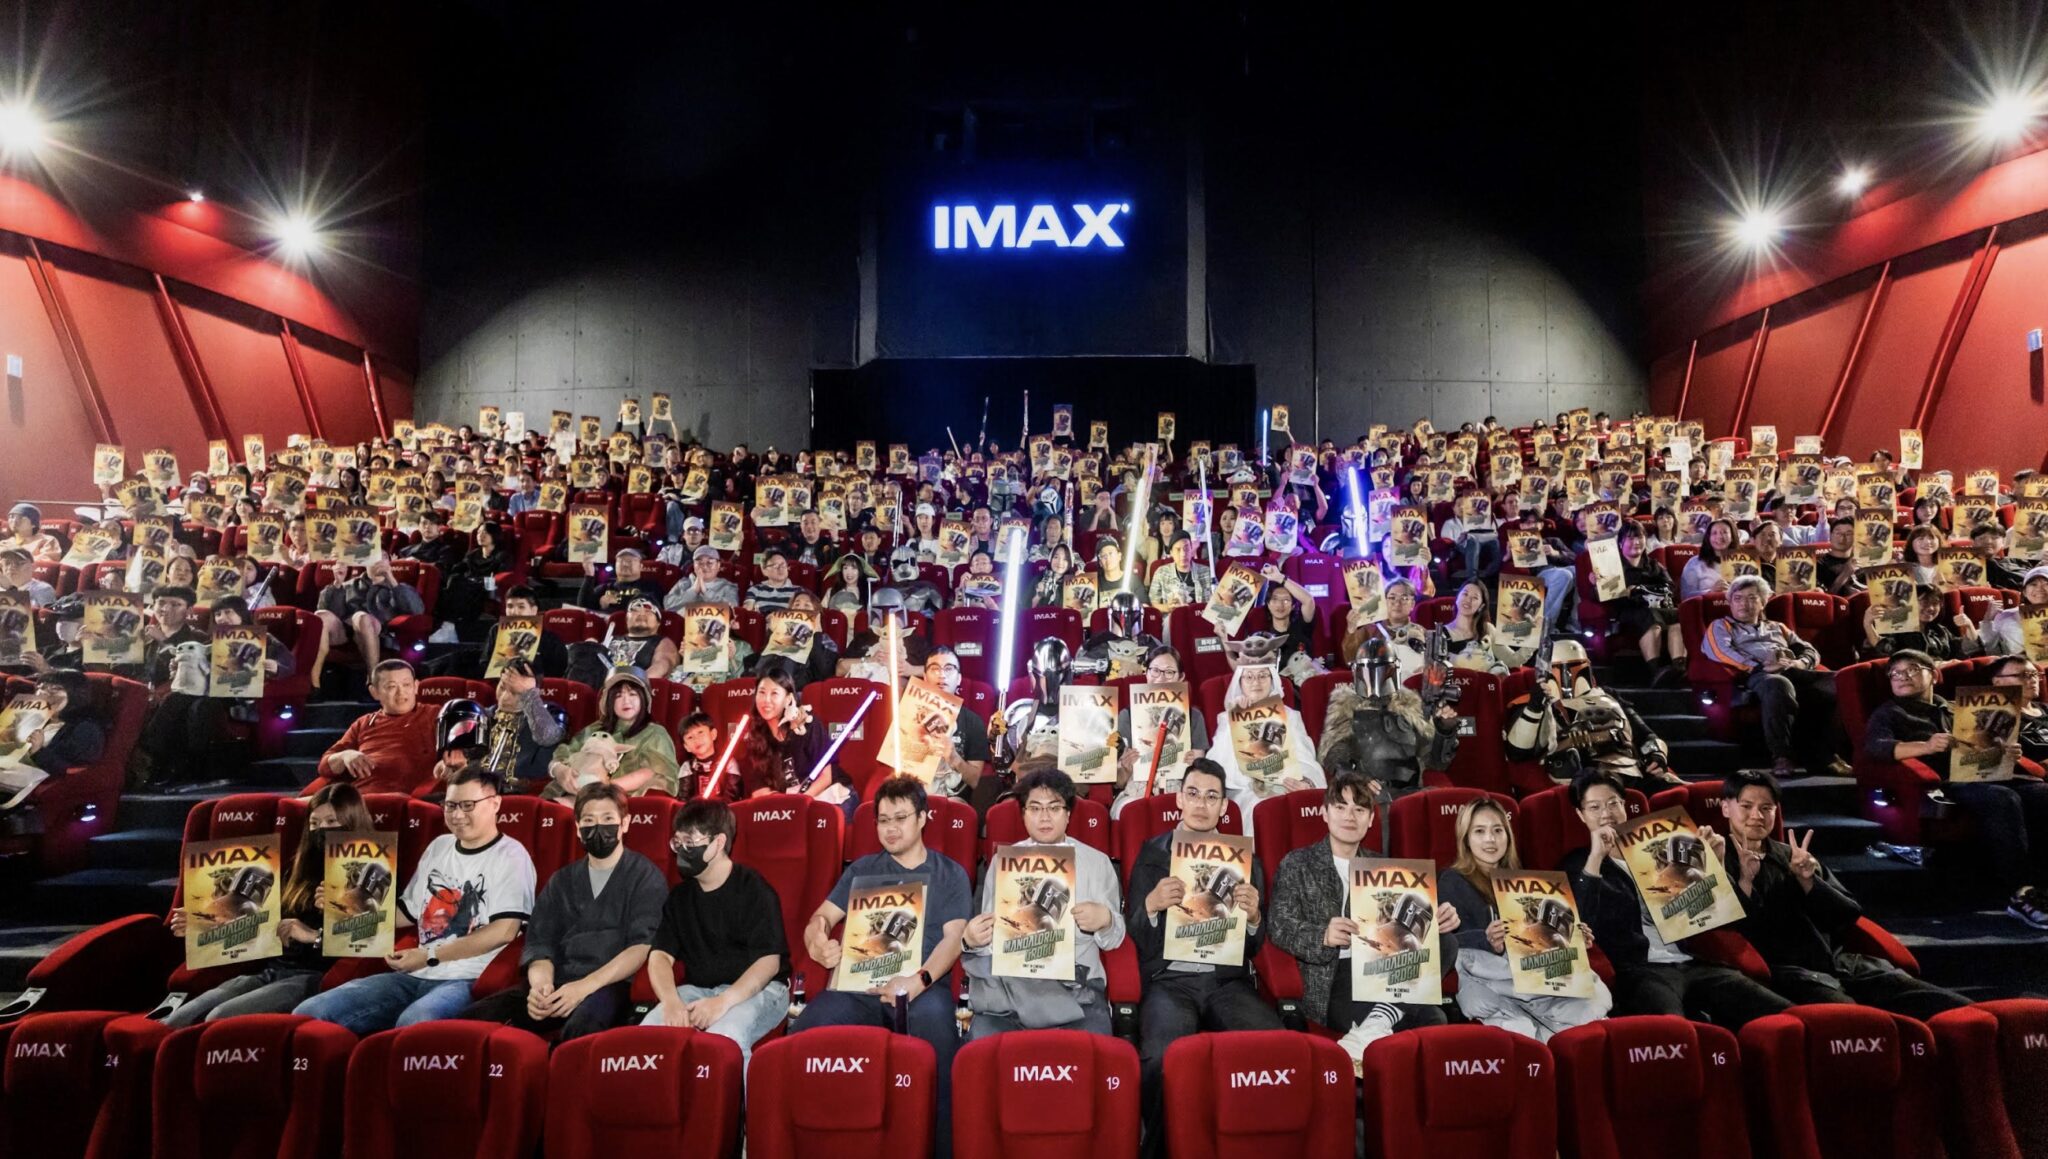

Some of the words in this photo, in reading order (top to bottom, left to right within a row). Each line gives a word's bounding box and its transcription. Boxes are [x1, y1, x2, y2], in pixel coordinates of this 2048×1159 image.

[935, 204, 1125, 248] IMAX
[1956, 499, 1994, 507] IMAX
[1393, 510, 1425, 518] IMAX
[1587, 506, 1621, 514] IMAX
[1856, 513, 1891, 522] IMAX
[1940, 552, 1983, 560] IMAX
[1228, 566, 1260, 586] IMAX
[1869, 569, 1909, 580] IMAX
[1066, 578, 1095, 586] IMAX
[1501, 581, 1541, 592] IMAX
[687, 608, 725, 617] IMAX
[215, 630, 262, 640] IMAX
[422, 688, 450, 696] IMAX
[1488, 683, 1495, 691] 15
[1133, 691, 1183, 704] IMAX
[1959, 694, 2012, 707] IMAX
[4, 701, 54, 710] IMAX
[1231, 706, 1281, 722] IMAX
[1630, 804, 1640, 814] 15
[1705, 798, 1723, 808] IM
[218, 811, 254, 822] IMAX
[753, 810, 792, 822] IMAX
[1440, 804, 1466, 816] IMA
[276, 816, 286, 826] 25
[409, 818, 420, 828] 24
[542, 818, 553, 827] 23
[630, 814, 653, 824] AX
[817, 818, 826, 828] 21
[952, 819, 964, 828] 20
[1088, 818, 1098, 828] 19
[1619, 816, 1687, 848] IMAX
[190, 846, 272, 868] IMAX
[329, 843, 391, 858] IMAX
[1176, 842, 1244, 864] IMAX
[1001, 857, 1068, 874] IMAX
[1354, 870, 1430, 888] IMAX
[1497, 879, 1566, 894] IMAX
[852, 892, 916, 911] IMAX
[1175, 917, 1238, 938] MANDALORIAN
[1003, 928, 1065, 953] MANDALORIAN
[1363, 948, 1430, 976] MANDALORIAN
[1830, 1038, 1883, 1054] IMAX
[2025, 1034, 2048, 1049] IM
[15, 1043, 67, 1058] IMAX
[206, 1048, 260, 1064] IMAX
[1629, 1043, 1685, 1063] IMAX
[1911, 1043, 1925, 1056] 15
[104, 1054, 120, 1068] 24
[293, 1058, 308, 1070] 23
[404, 1055, 459, 1070] IMAX
[602, 1054, 658, 1073] IMAX
[1712, 1052, 1726, 1065] 16
[488, 1064, 503, 1077] 22
[696, 1065, 710, 1078] 21
[806, 1058, 864, 1073] IMAX
[1446, 1058, 1501, 1076] IMAX
[1527, 1064, 1541, 1078] 17
[1014, 1066, 1073, 1082] IMAX
[1231, 1070, 1292, 1088] IMAX
[1324, 1071, 1338, 1084] 18
[895, 1074, 911, 1088] 20
[1106, 1076, 1120, 1090] 19
